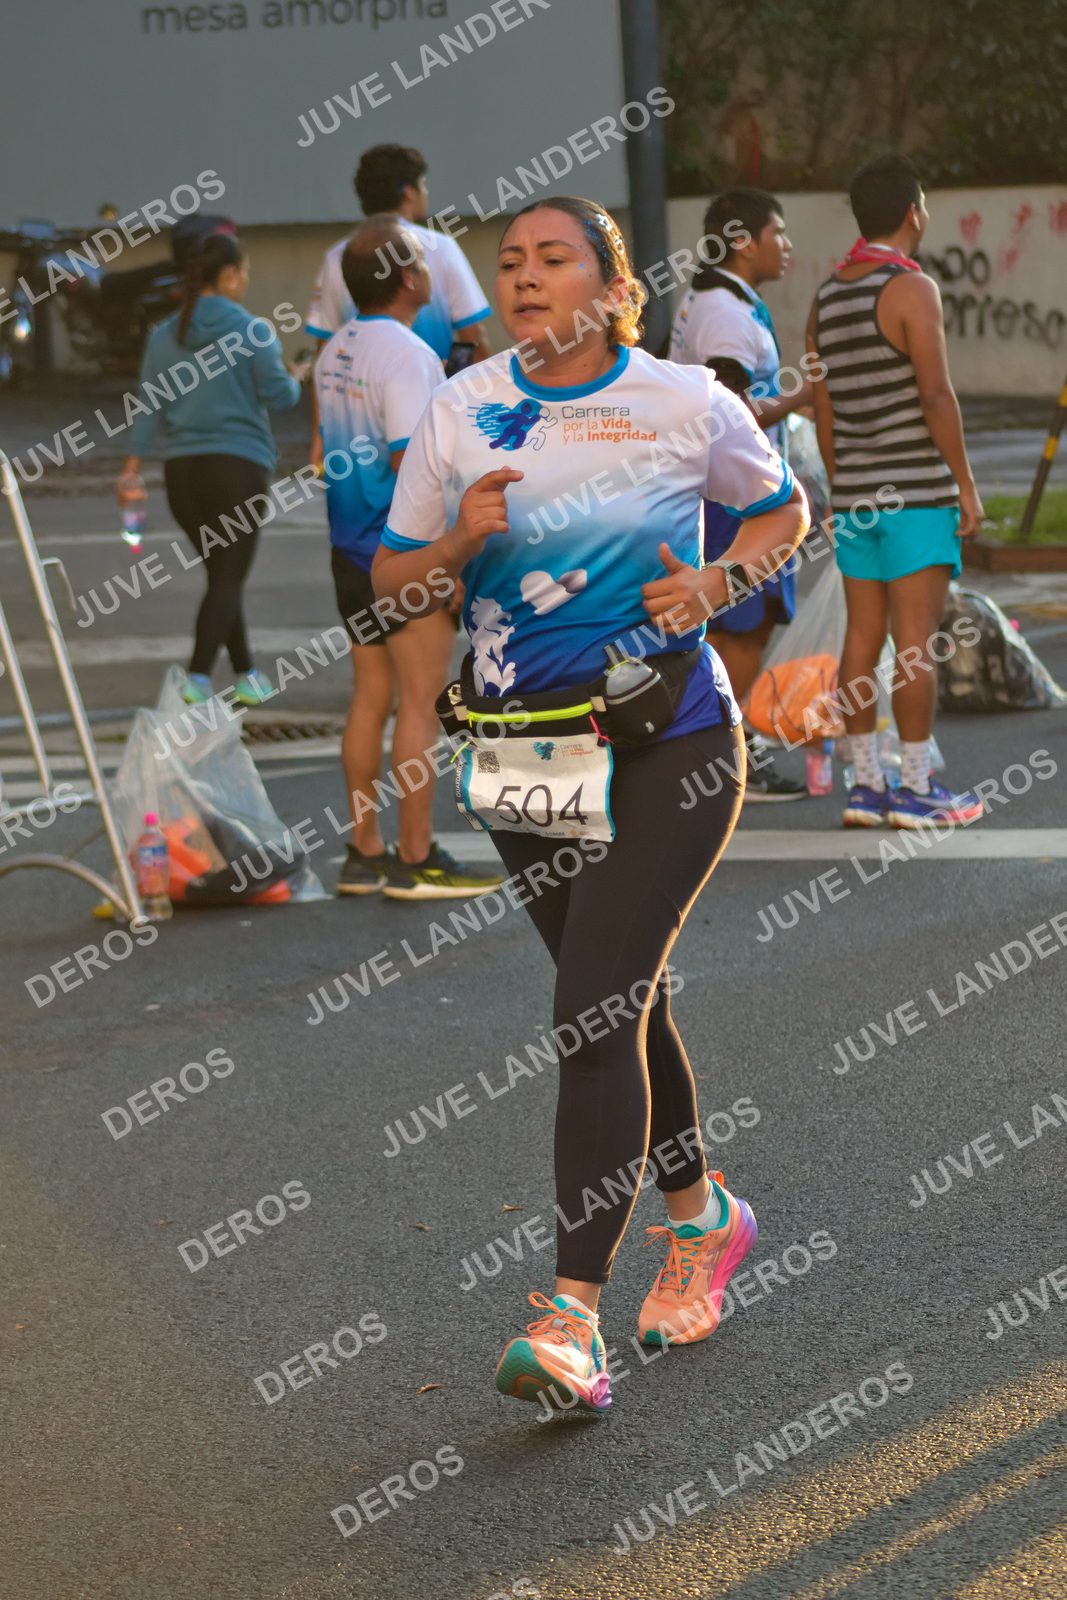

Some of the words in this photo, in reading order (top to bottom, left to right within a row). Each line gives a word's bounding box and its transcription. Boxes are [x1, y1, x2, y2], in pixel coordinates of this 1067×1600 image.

[140, 3, 248, 33] mesa
[562, 405, 630, 419] Carrera
[563, 422, 584, 434] por
[587, 419, 598, 430] la
[600, 418, 631, 430] Vida
[563, 434, 570, 445] y
[573, 431, 584, 442] la
[587, 429, 657, 444] Integridad
[494, 782, 588, 827] 504
